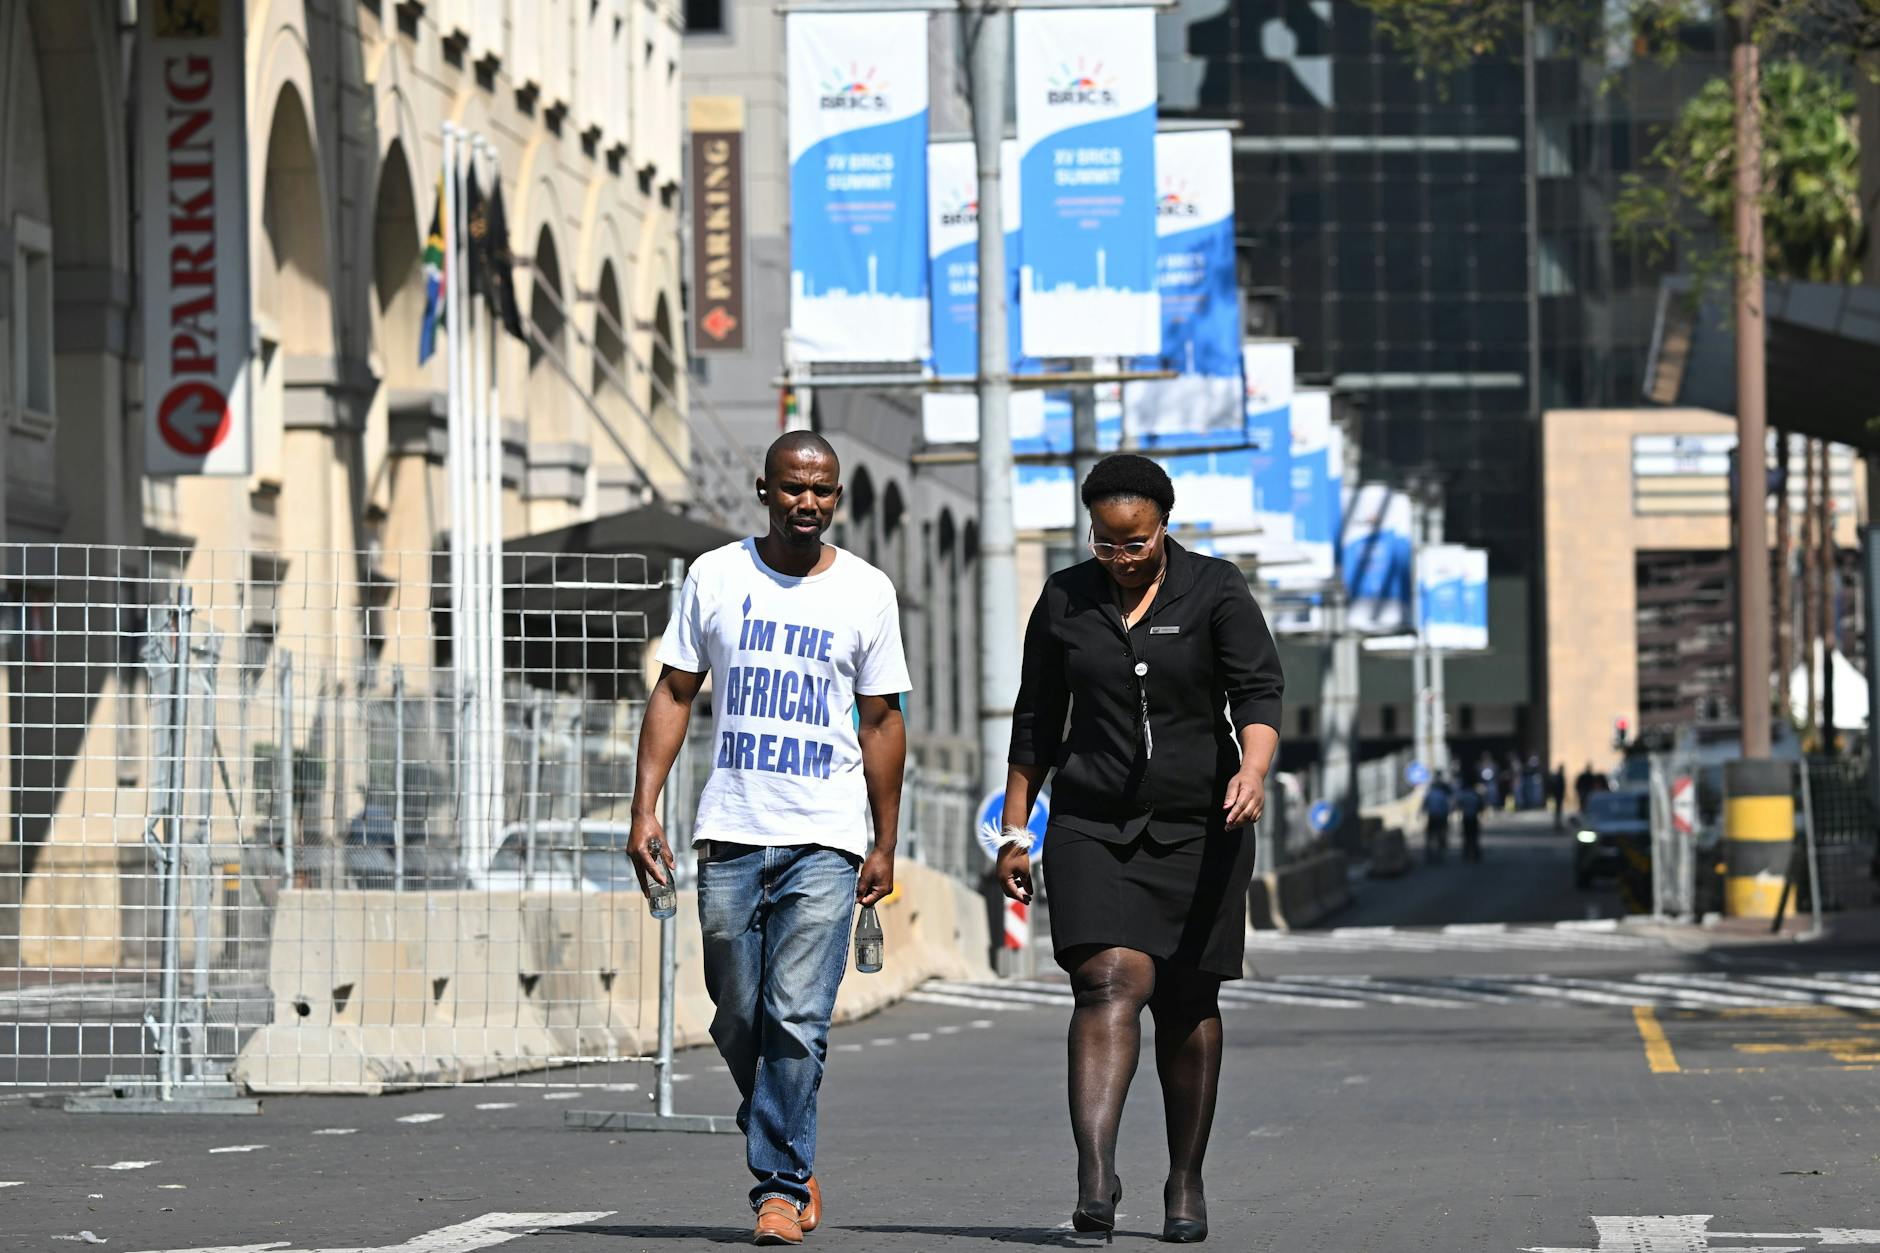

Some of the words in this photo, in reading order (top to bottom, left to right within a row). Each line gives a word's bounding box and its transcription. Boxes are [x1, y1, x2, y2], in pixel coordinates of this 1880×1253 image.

[849, 153, 893, 171] BRICS
[1076, 147, 1122, 165] BRICS
[827, 173, 893, 191] SUMMIT
[1055, 167, 1122, 185] SUMMIT
[164, 54, 218, 376] PARKING
[704, 139, 731, 299] PARKING
[784, 624, 834, 662] THE
[727, 666, 831, 727] AFRICAN
[717, 731, 834, 779] DREAM
